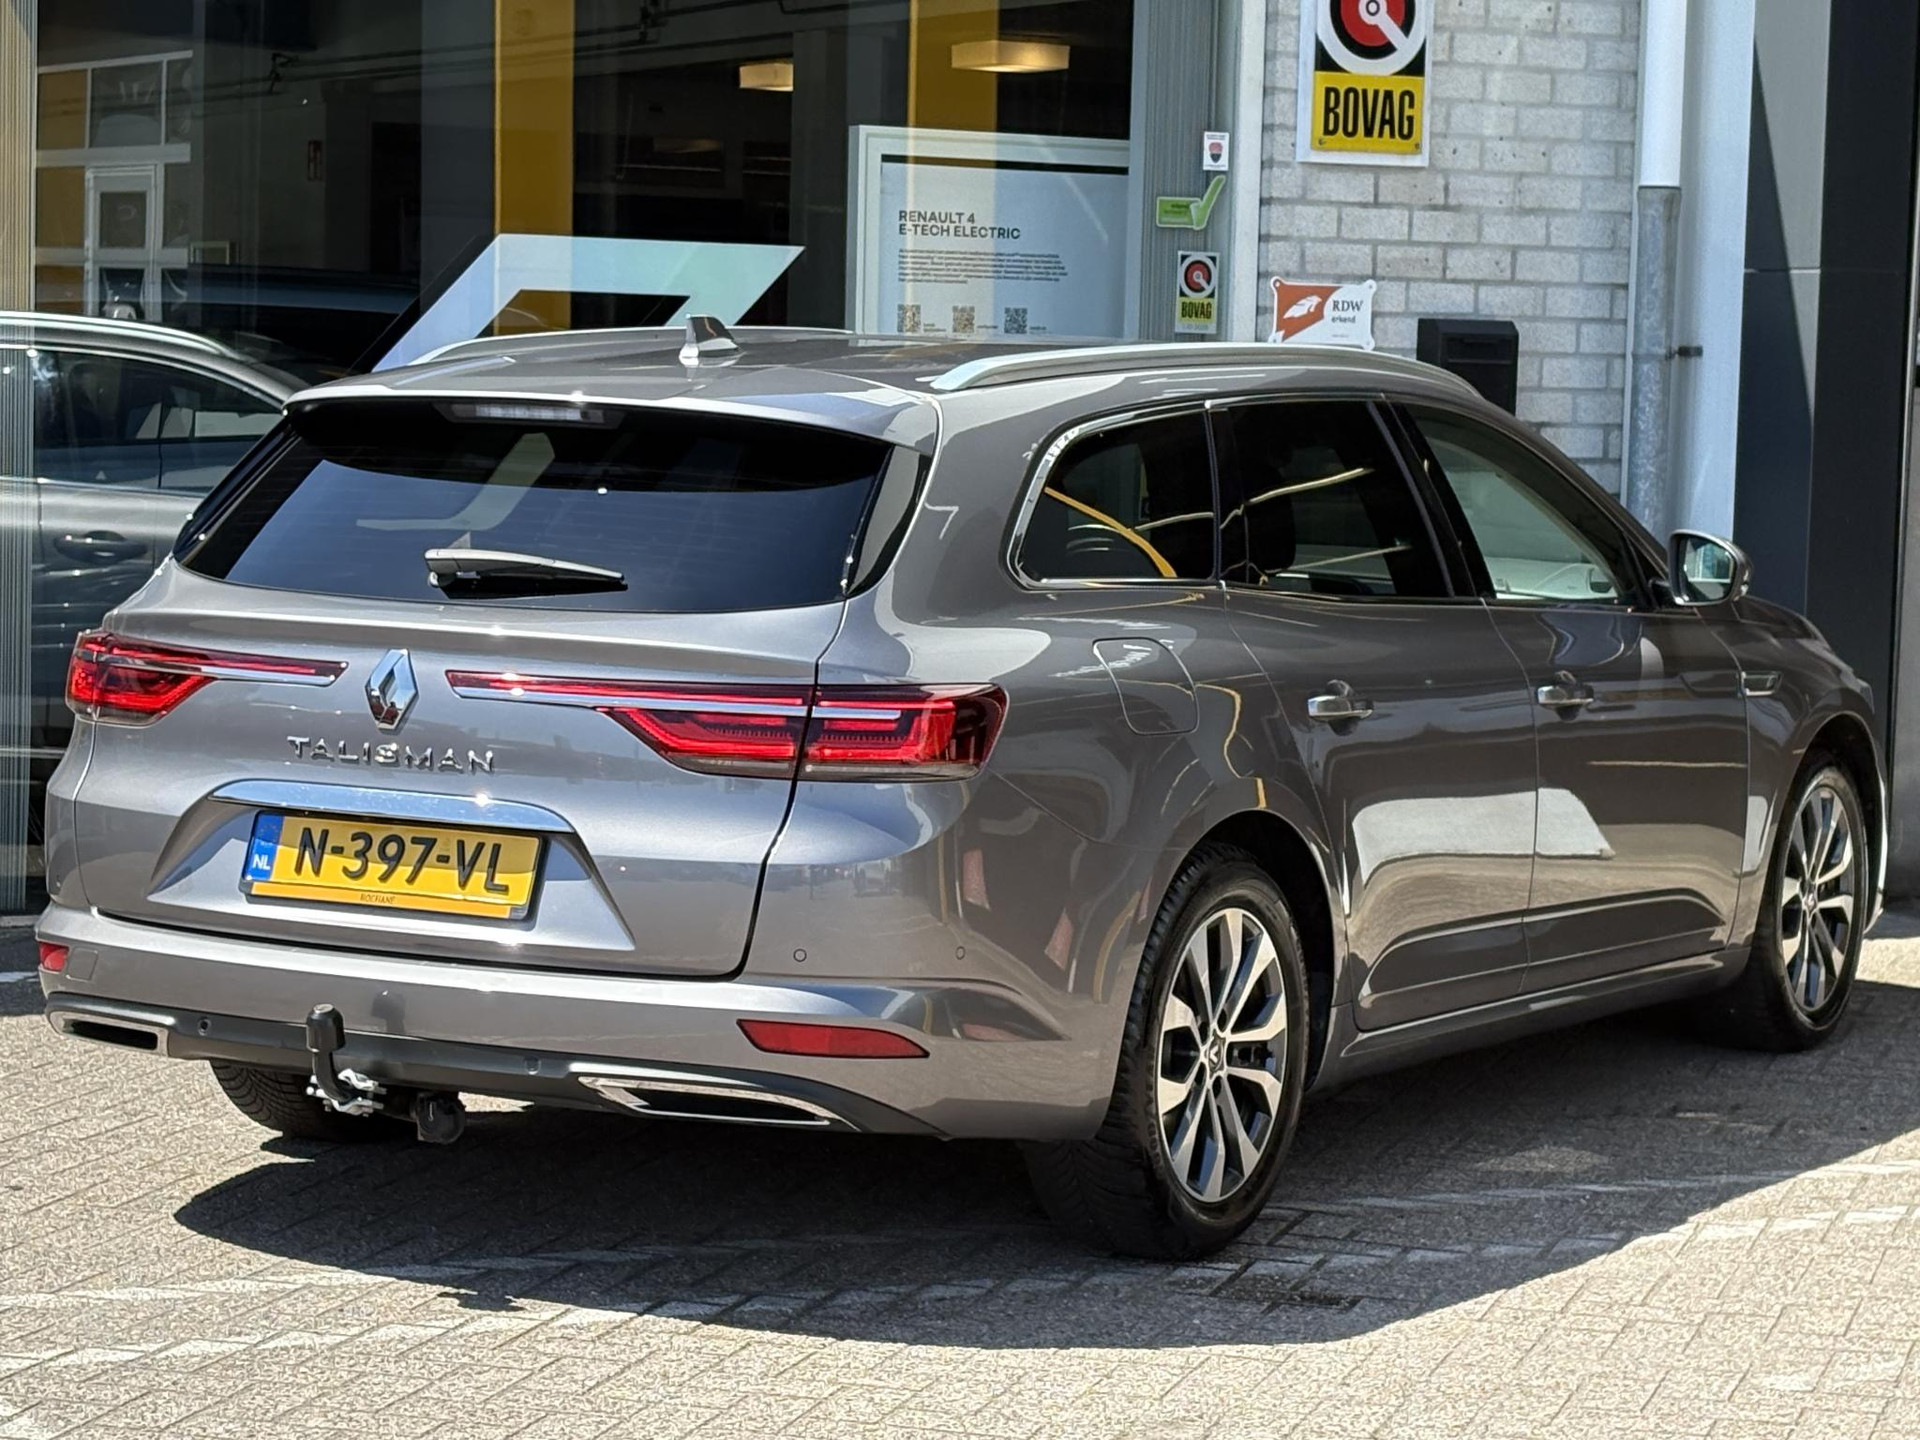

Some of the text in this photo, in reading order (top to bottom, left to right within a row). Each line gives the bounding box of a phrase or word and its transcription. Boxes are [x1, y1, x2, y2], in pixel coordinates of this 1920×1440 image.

[1322, 86, 1415, 140] BOVAG
[899, 210, 975, 224] RENAULT 4
[899, 223, 1021, 239] E-TECH ELECTRIC
[1181, 301, 1212, 319] BOVAG
[1332, 300, 1363, 312] RDW
[287, 736, 495, 773] TALISMAN
[252, 827, 510, 895] NL N-397-VL
